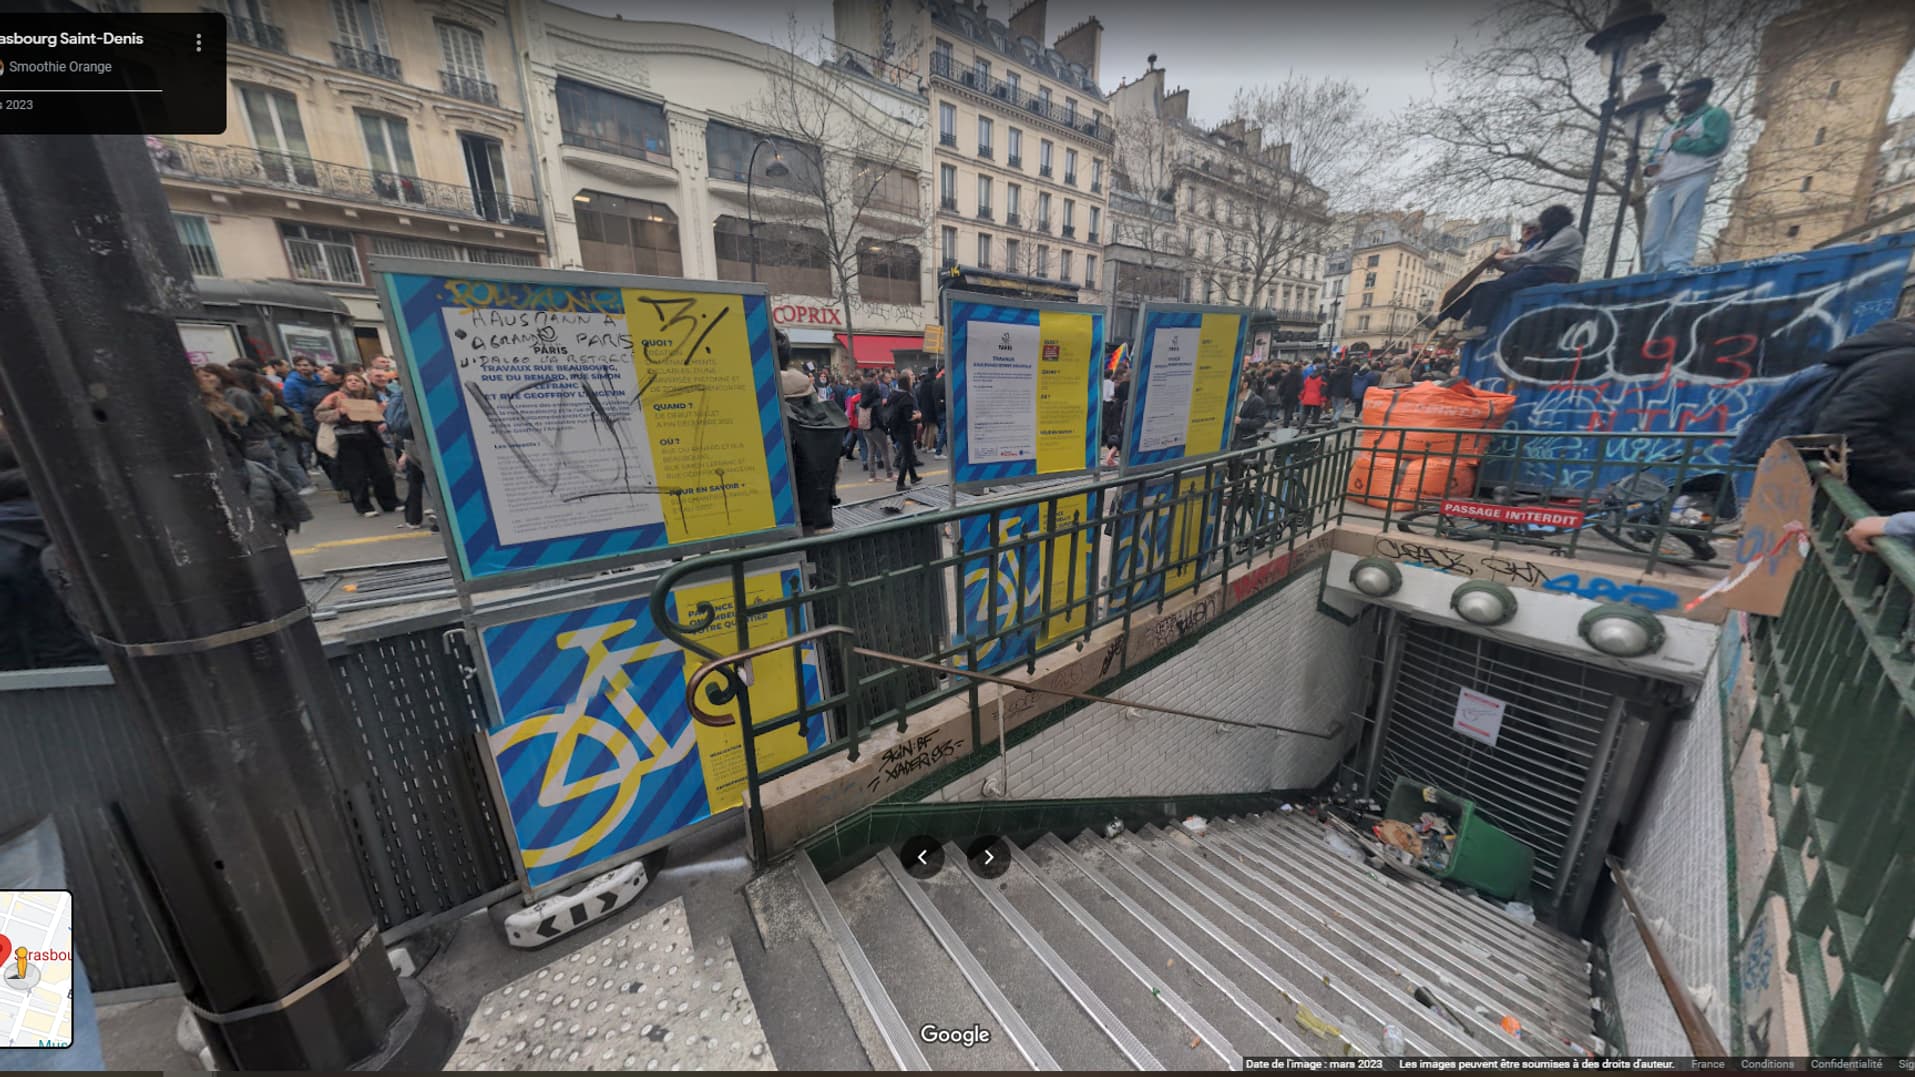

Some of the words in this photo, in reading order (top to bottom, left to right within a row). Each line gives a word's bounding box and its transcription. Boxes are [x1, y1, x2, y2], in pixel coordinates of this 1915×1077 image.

[641, 339, 667, 347] QUOI
[534, 344, 569, 355] PARIS
[482, 364, 532, 372] TRAVAUX
[534, 364, 554, 372] RUE
[481, 374, 503, 382] RUE
[523, 391, 577, 400] GEOFFROY
[653, 403, 686, 411] QUAND
[1444, 503, 1500, 518] PASSAGE
